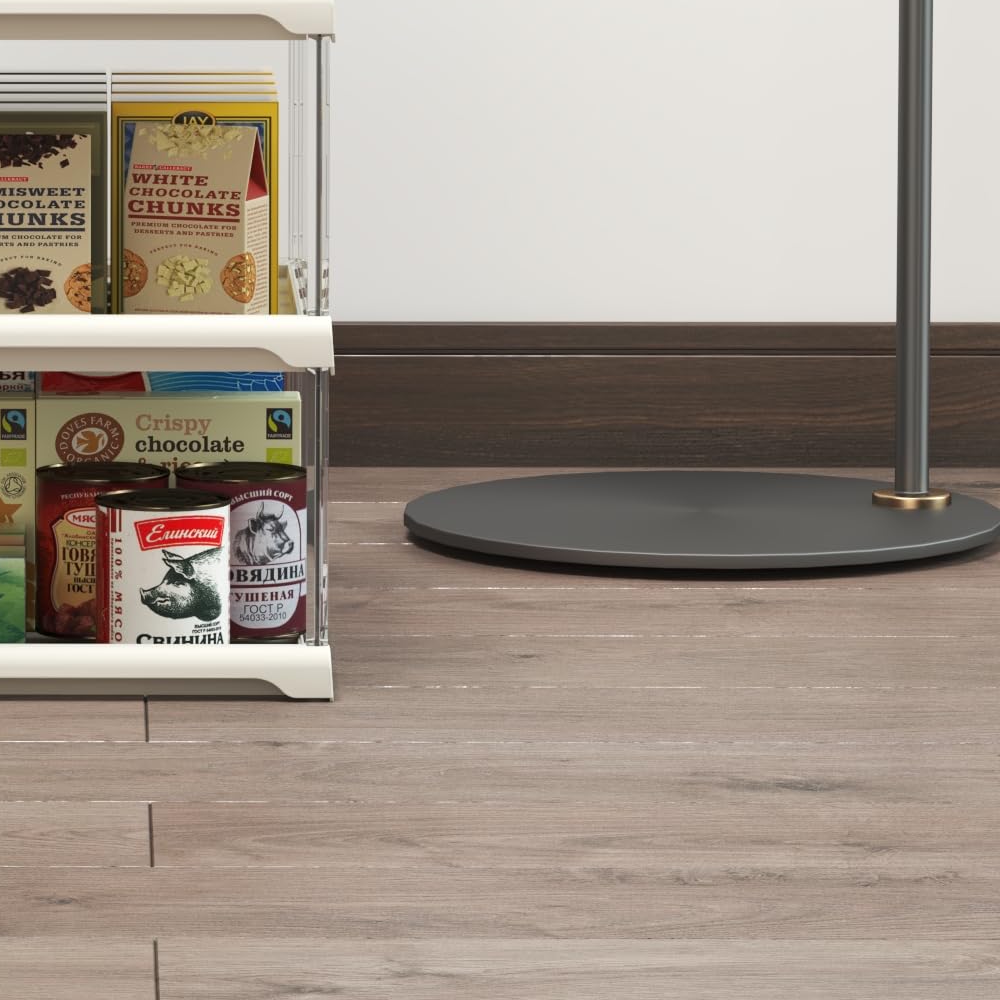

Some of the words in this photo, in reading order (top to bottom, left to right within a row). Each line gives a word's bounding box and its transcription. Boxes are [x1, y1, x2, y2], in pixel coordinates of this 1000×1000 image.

[131, 173, 208, 186] WHITE
[129, 187, 241, 200] CHOCOLATE
[128, 200, 240, 216] CHUNKS
[60, 418, 87, 450] DOVES
[90, 416, 118, 438] FARM
[135, 414, 212, 435] Crispy
[135, 436, 245, 453] chocolate
[230, 488, 272, 505] ВЫСШИЙ
[274, 490, 293, 502] СОРТ
[146, 524, 218, 543] Елинский
[114, 538, 123, 580] 100%
[67, 584, 93, 594] ГОСТ
[114, 591, 123, 642] МЯСО
[240, 612, 286, 621] 54033-2010
[243, 604, 273, 614] ГОСТ
[276, 603, 283, 612] Р
